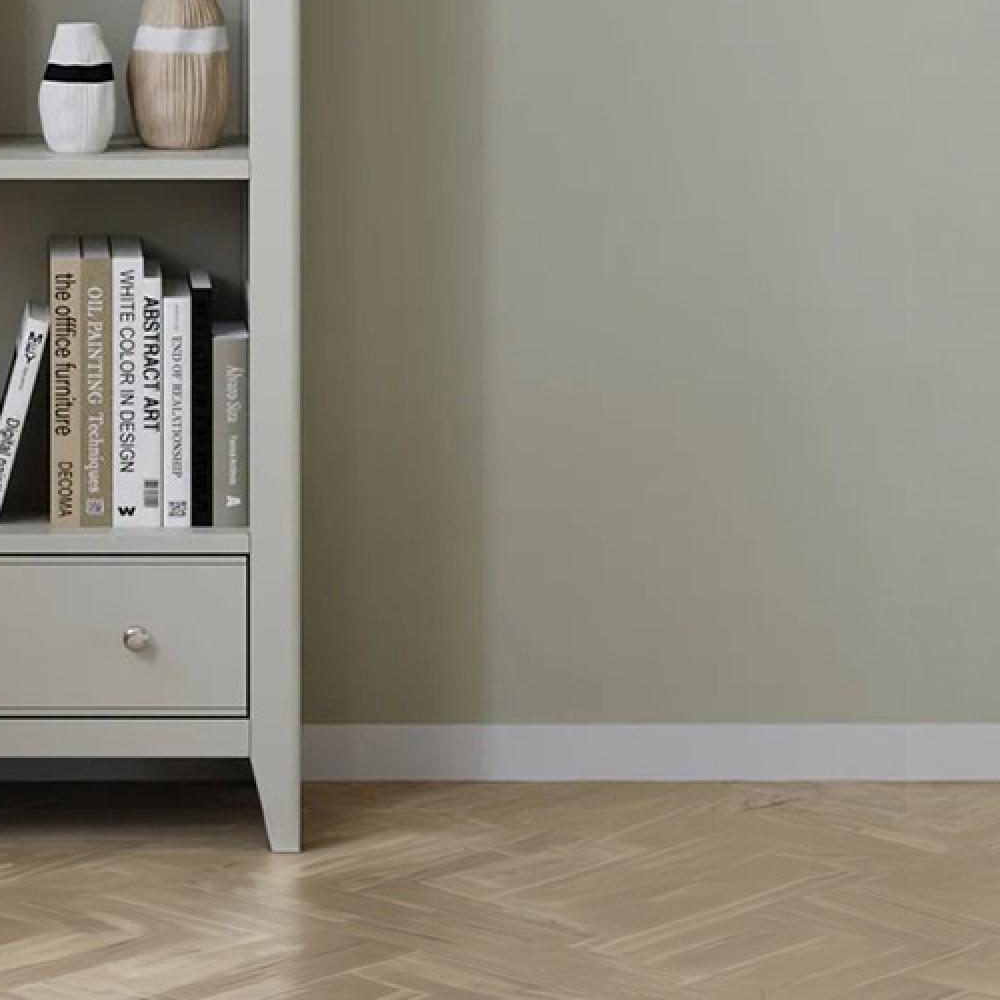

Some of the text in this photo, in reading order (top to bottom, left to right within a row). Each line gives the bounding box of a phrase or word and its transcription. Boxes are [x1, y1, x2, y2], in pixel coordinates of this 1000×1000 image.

[54, 273, 75, 300] the
[120, 270, 134, 473] WHITE COLOR IN DESIGN
[143, 296, 160, 432] ABSTRACT ART
[172, 336, 182, 362] END
[172, 364, 182, 379] OF
[53, 362, 76, 436] furniture
[84, 287, 104, 492] OIL PAINTING Techniques
[58, 462, 72, 517] DECOMA
